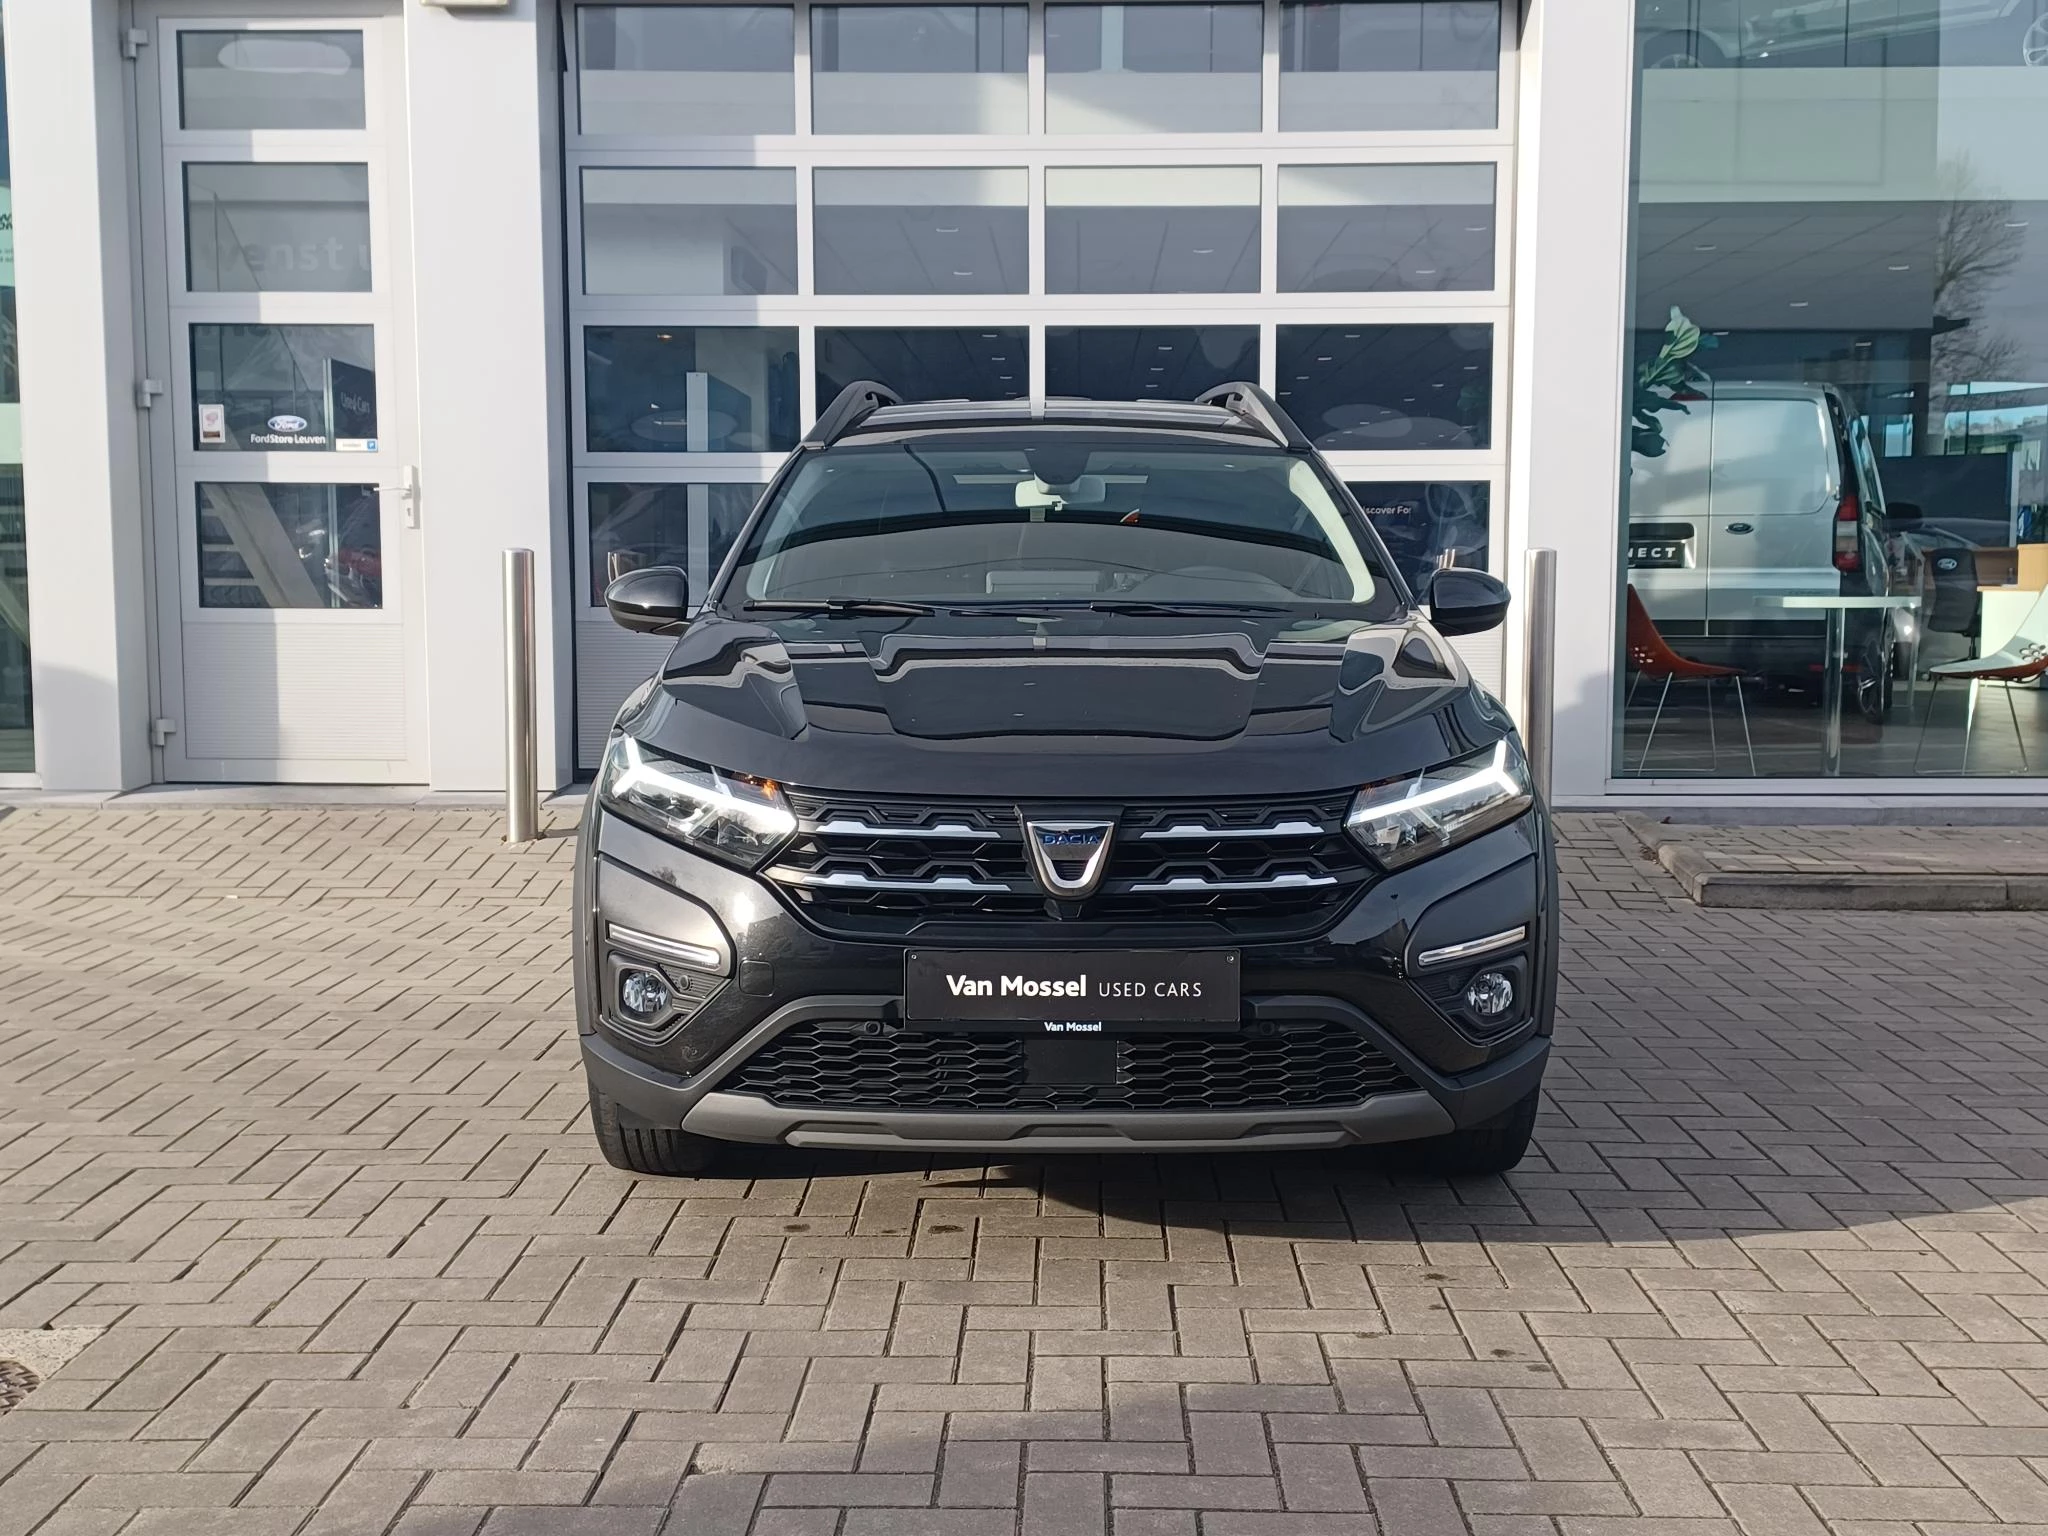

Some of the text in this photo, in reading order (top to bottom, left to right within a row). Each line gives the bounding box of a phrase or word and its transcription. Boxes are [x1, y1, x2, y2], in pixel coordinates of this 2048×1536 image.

[250, 433, 326, 444] FordStore Leuven
[1042, 834, 1101, 845] DACIA
[946, 974, 1202, 997] Van Mossel USED CARS
[1044, 1021, 1102, 1032] Van Mossel
